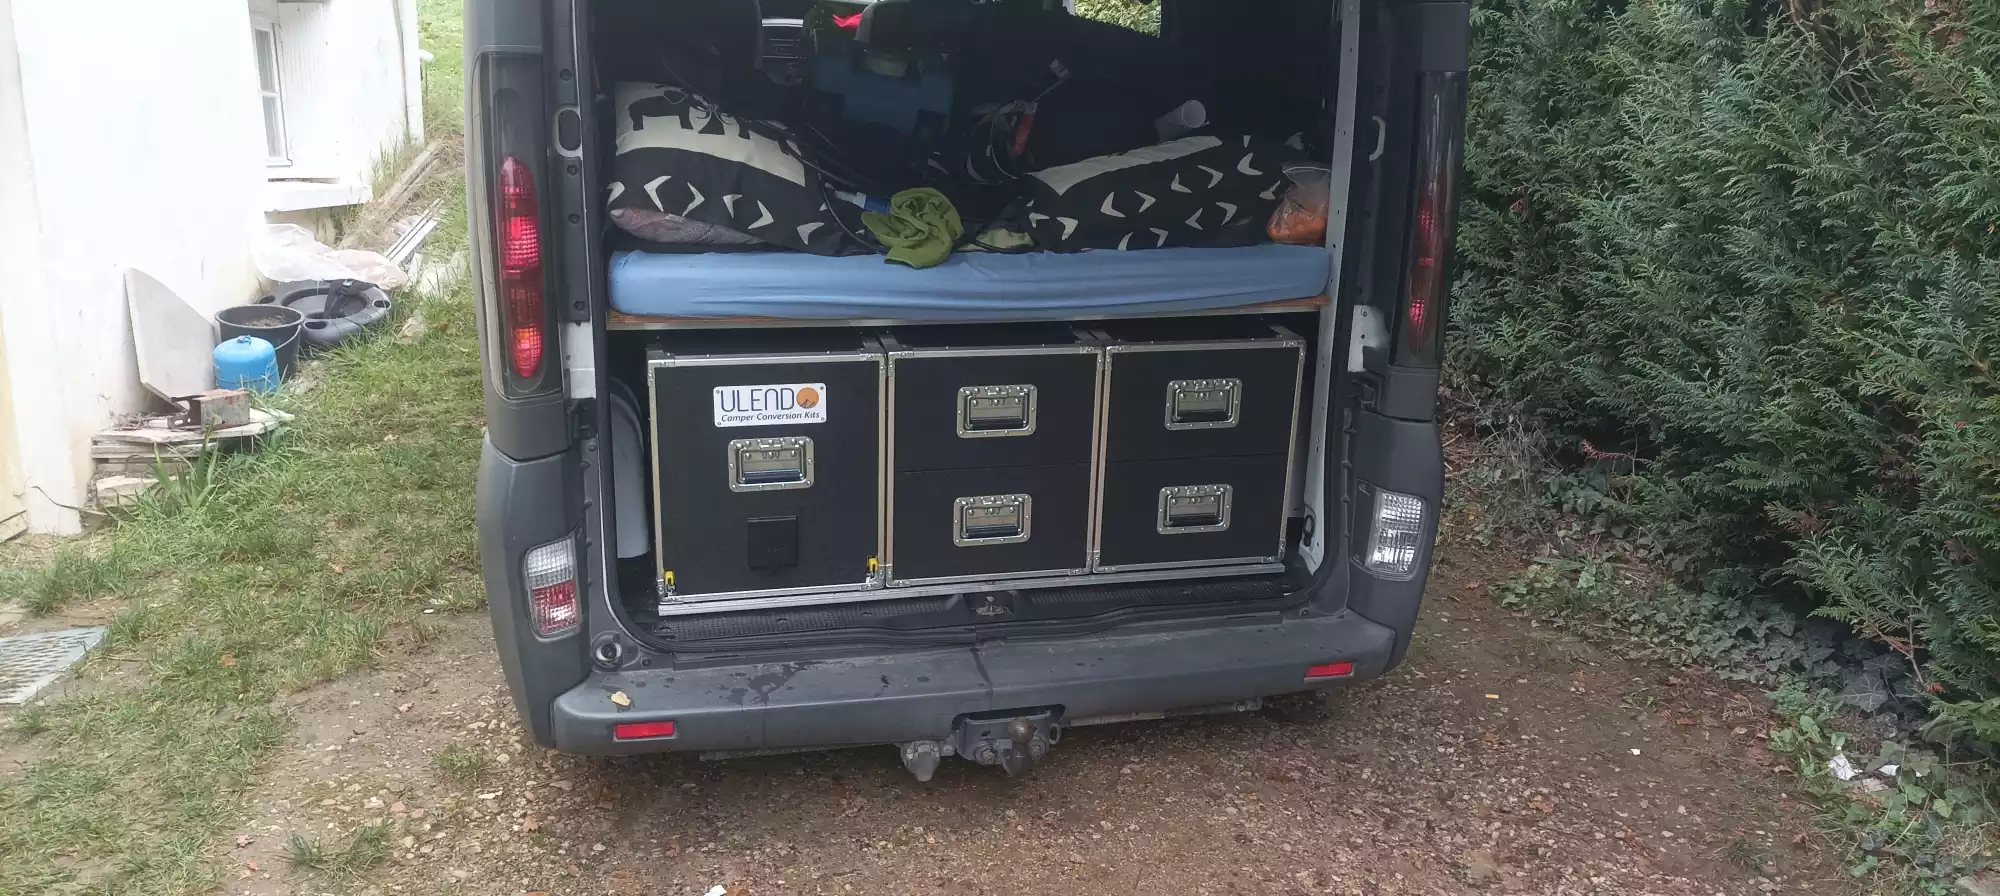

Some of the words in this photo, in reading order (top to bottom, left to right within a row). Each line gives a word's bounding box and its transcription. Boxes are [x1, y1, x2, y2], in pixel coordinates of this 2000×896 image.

[721, 414, 754, 423] Camper
[756, 412, 802, 421] Conversion
[804, 411, 820, 419] Kits
